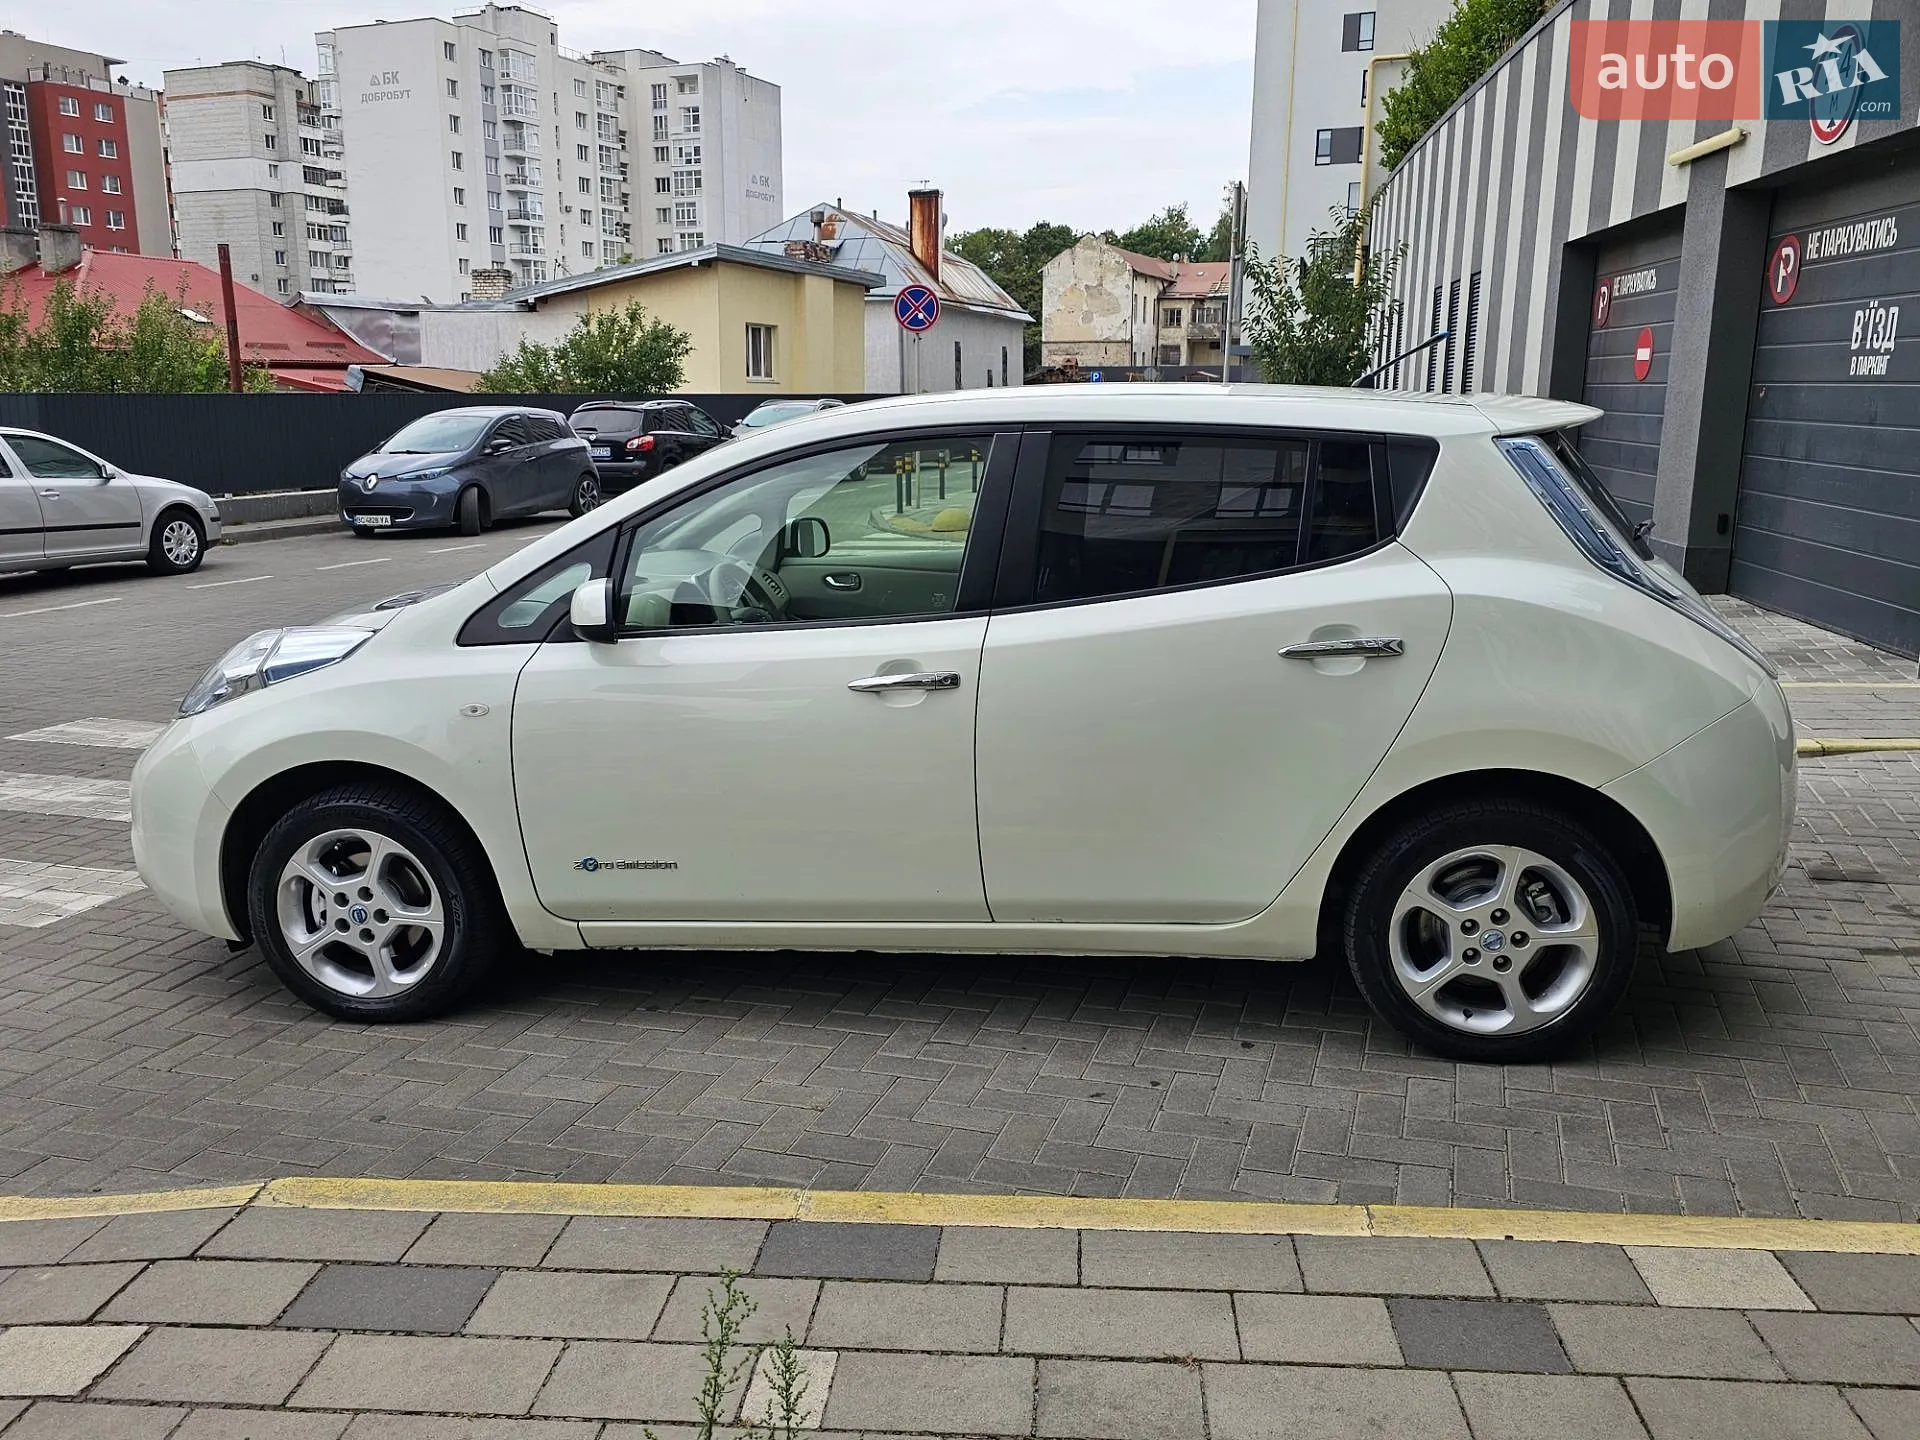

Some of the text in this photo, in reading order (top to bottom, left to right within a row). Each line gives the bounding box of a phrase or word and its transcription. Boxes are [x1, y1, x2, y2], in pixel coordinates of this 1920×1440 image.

[382, 71, 400, 85] БК
[361, 89, 411, 104] ДОБРОБУТ
[1806, 216, 1898, 260] НЕ ПАРКУВАТИСЬ
[1620, 268, 1657, 296] ПАРКУВАТИСЬ
[1849, 355, 1890, 376] В ПАРКІНГ
